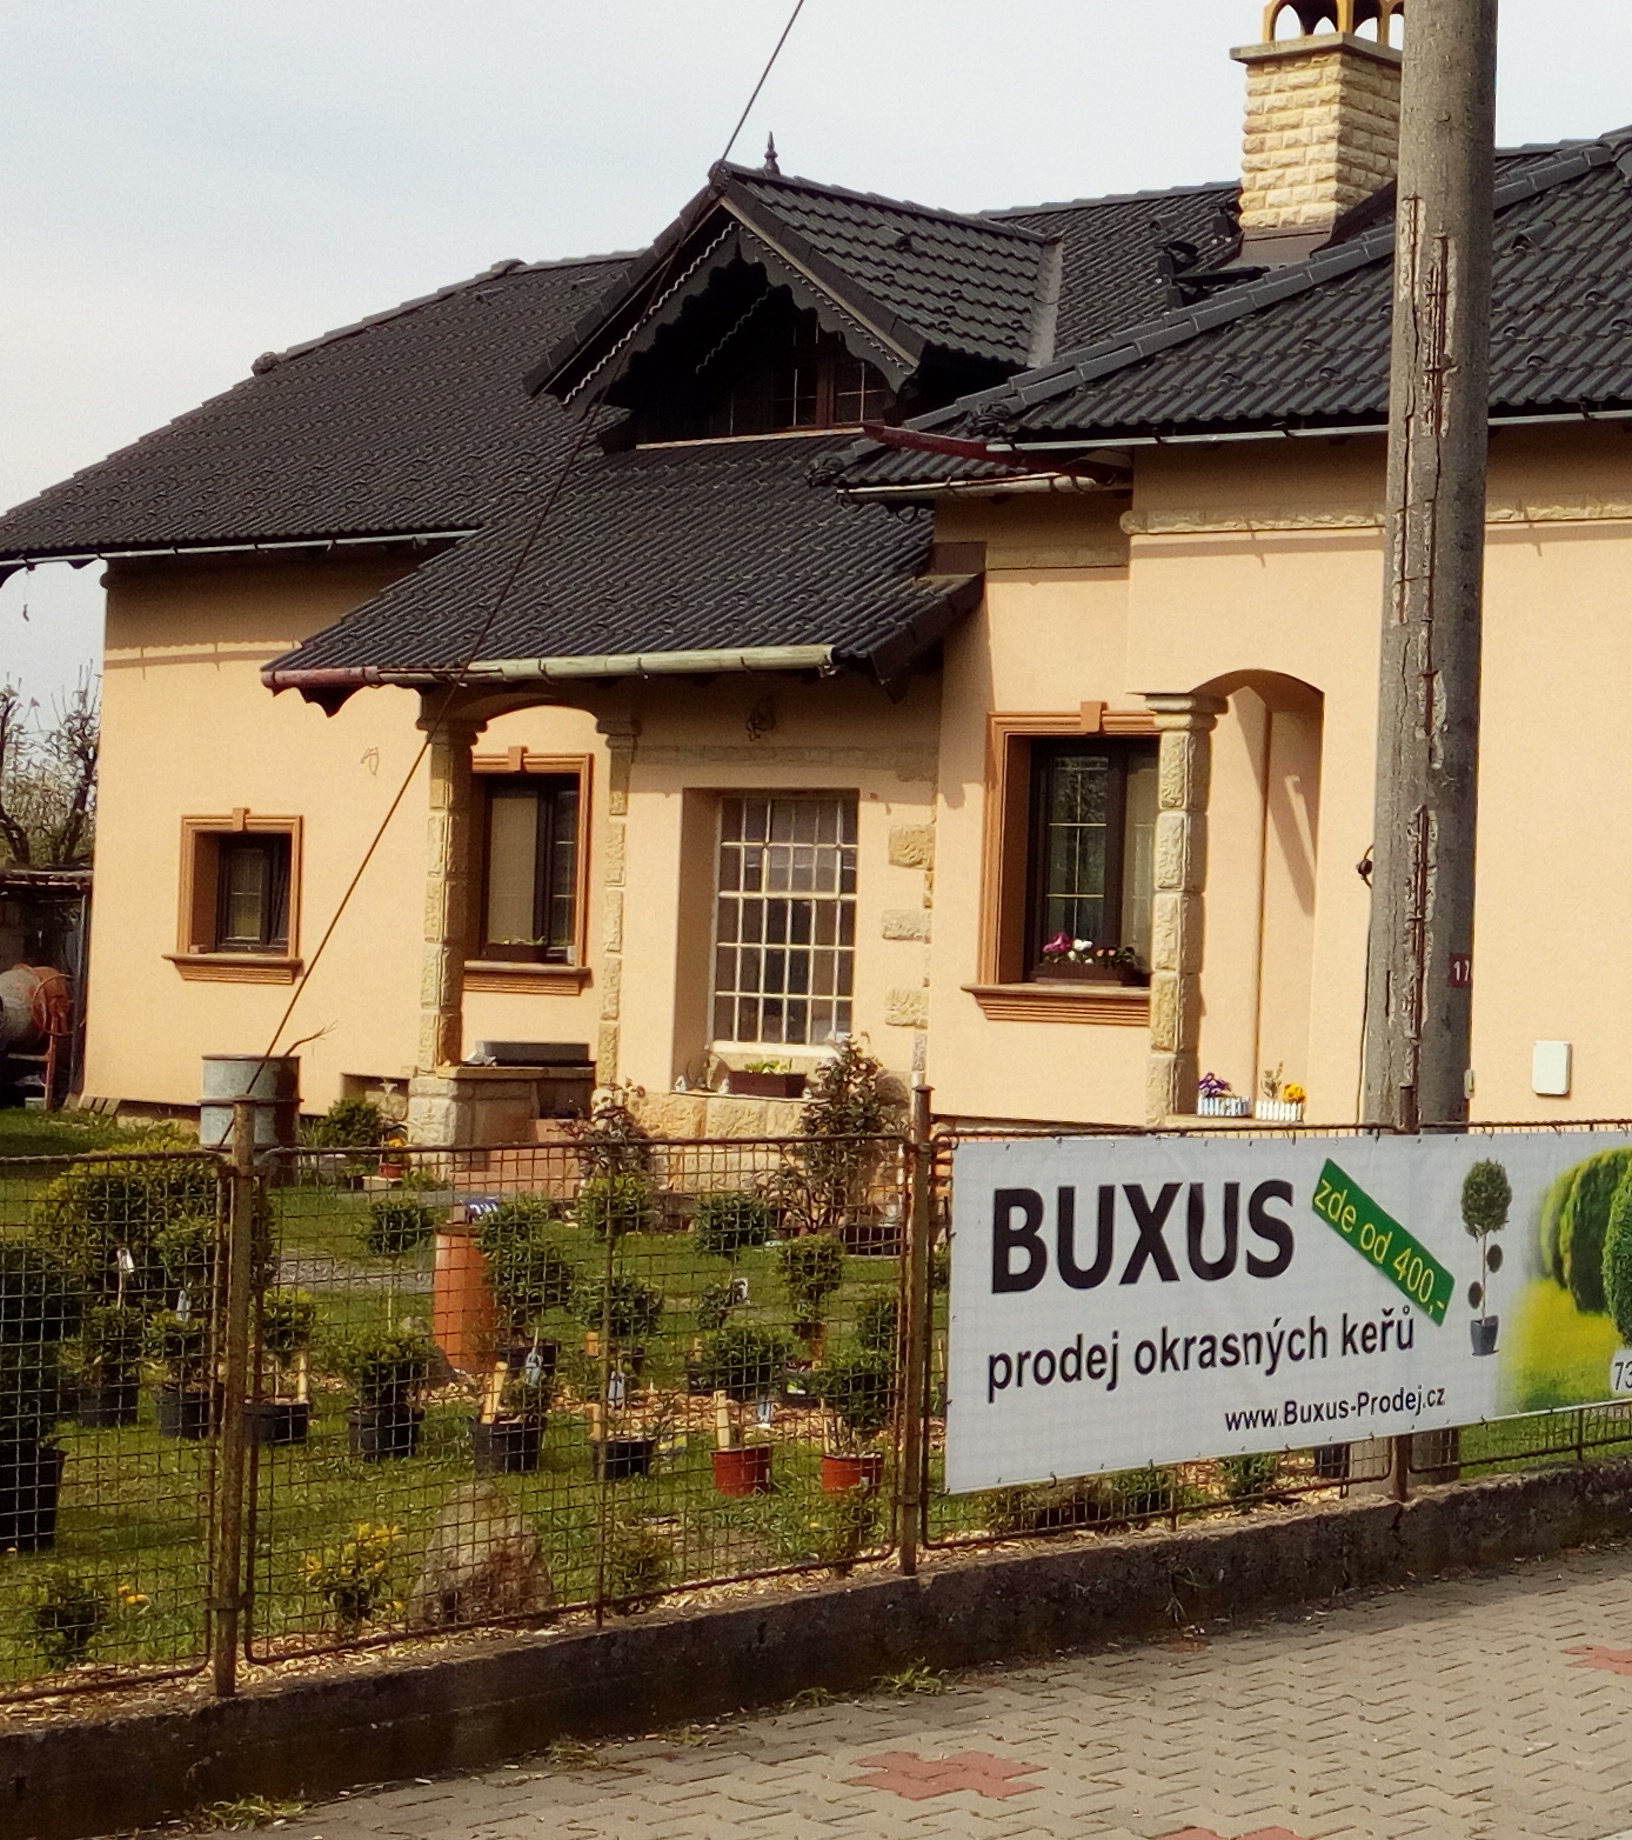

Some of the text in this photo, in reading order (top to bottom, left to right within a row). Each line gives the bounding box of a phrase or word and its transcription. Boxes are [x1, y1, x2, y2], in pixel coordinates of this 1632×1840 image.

[990, 1178, 1294, 1294] BUXUS
[1314, 1178, 1357, 1233] zde
[1360, 1223, 1393, 1264] od
[988, 1306, 1415, 1403] prodej okrasných keřů
[1225, 1386, 1446, 1432] www.Buxus-Prodej.cz
